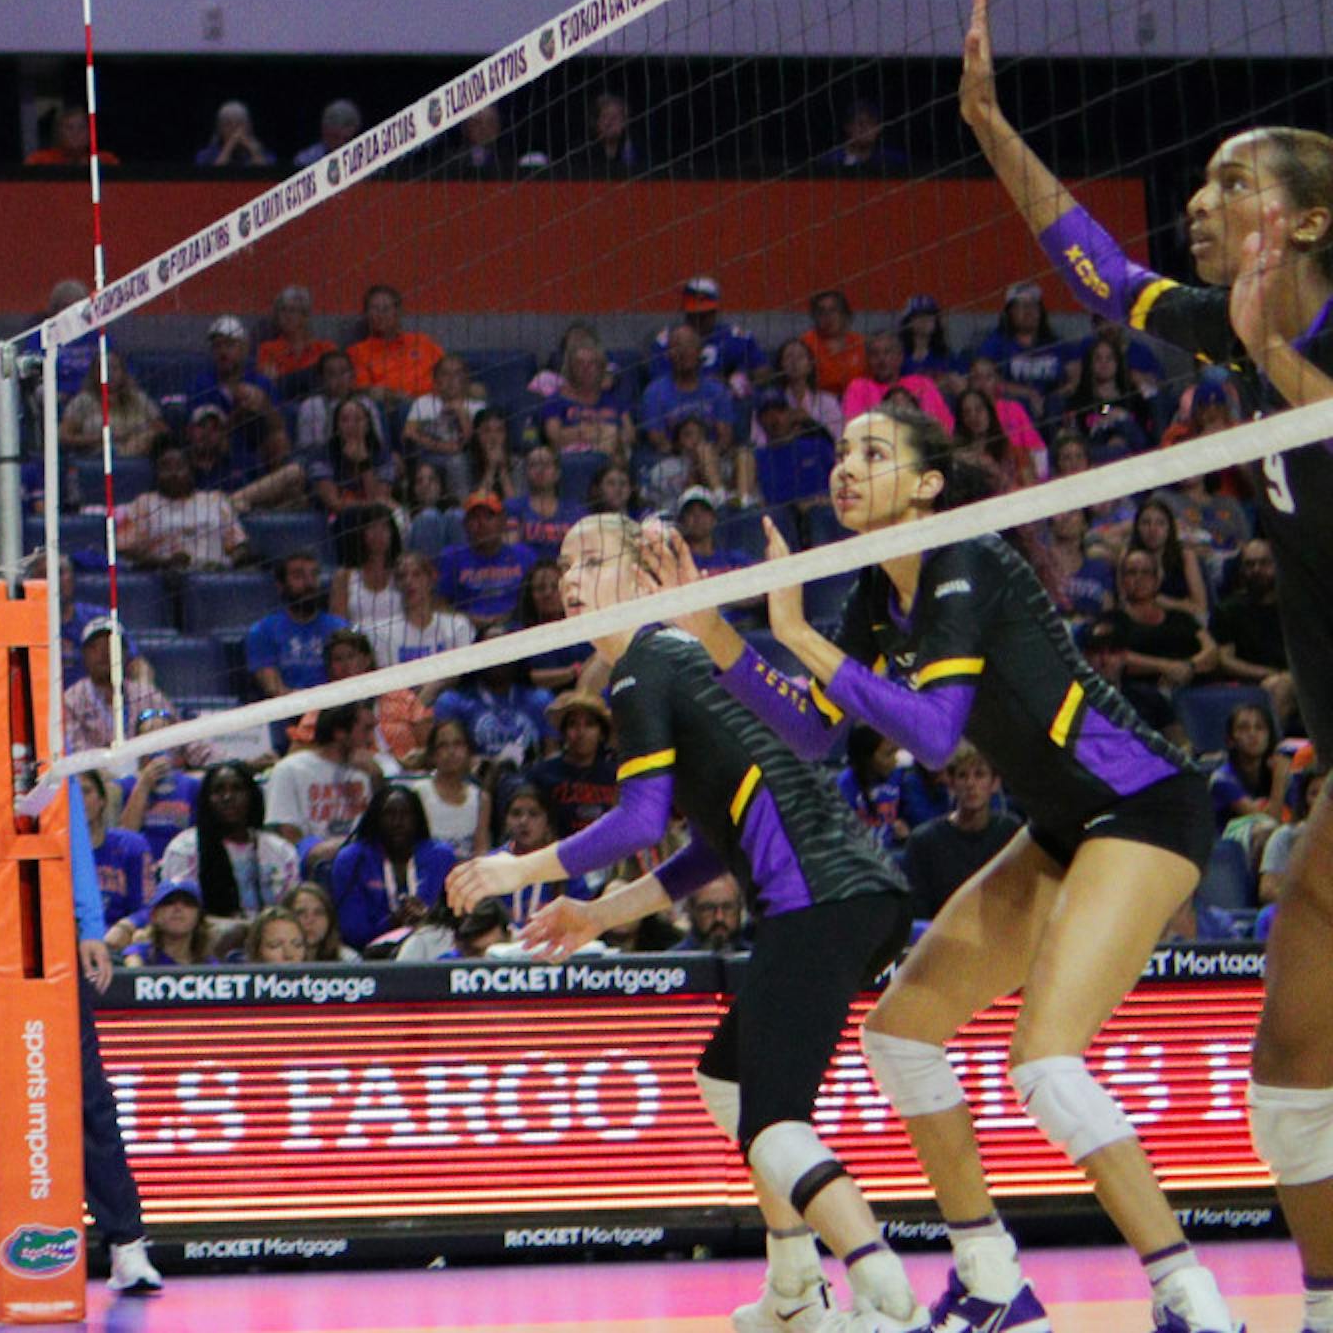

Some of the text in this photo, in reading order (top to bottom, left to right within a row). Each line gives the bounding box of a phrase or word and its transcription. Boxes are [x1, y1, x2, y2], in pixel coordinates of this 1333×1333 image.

[135, 973, 376, 1003] ROCKET Mortgage
[451, 966, 686, 995] ROCKET Mortgage
[21, 1019, 52, 1200] sports imports
[280, 1049, 661, 1151] FARGO
[185, 1236, 348, 1259] ROCKET Mortgage
[504, 1225, 664, 1248] ROCKET Mortgage
